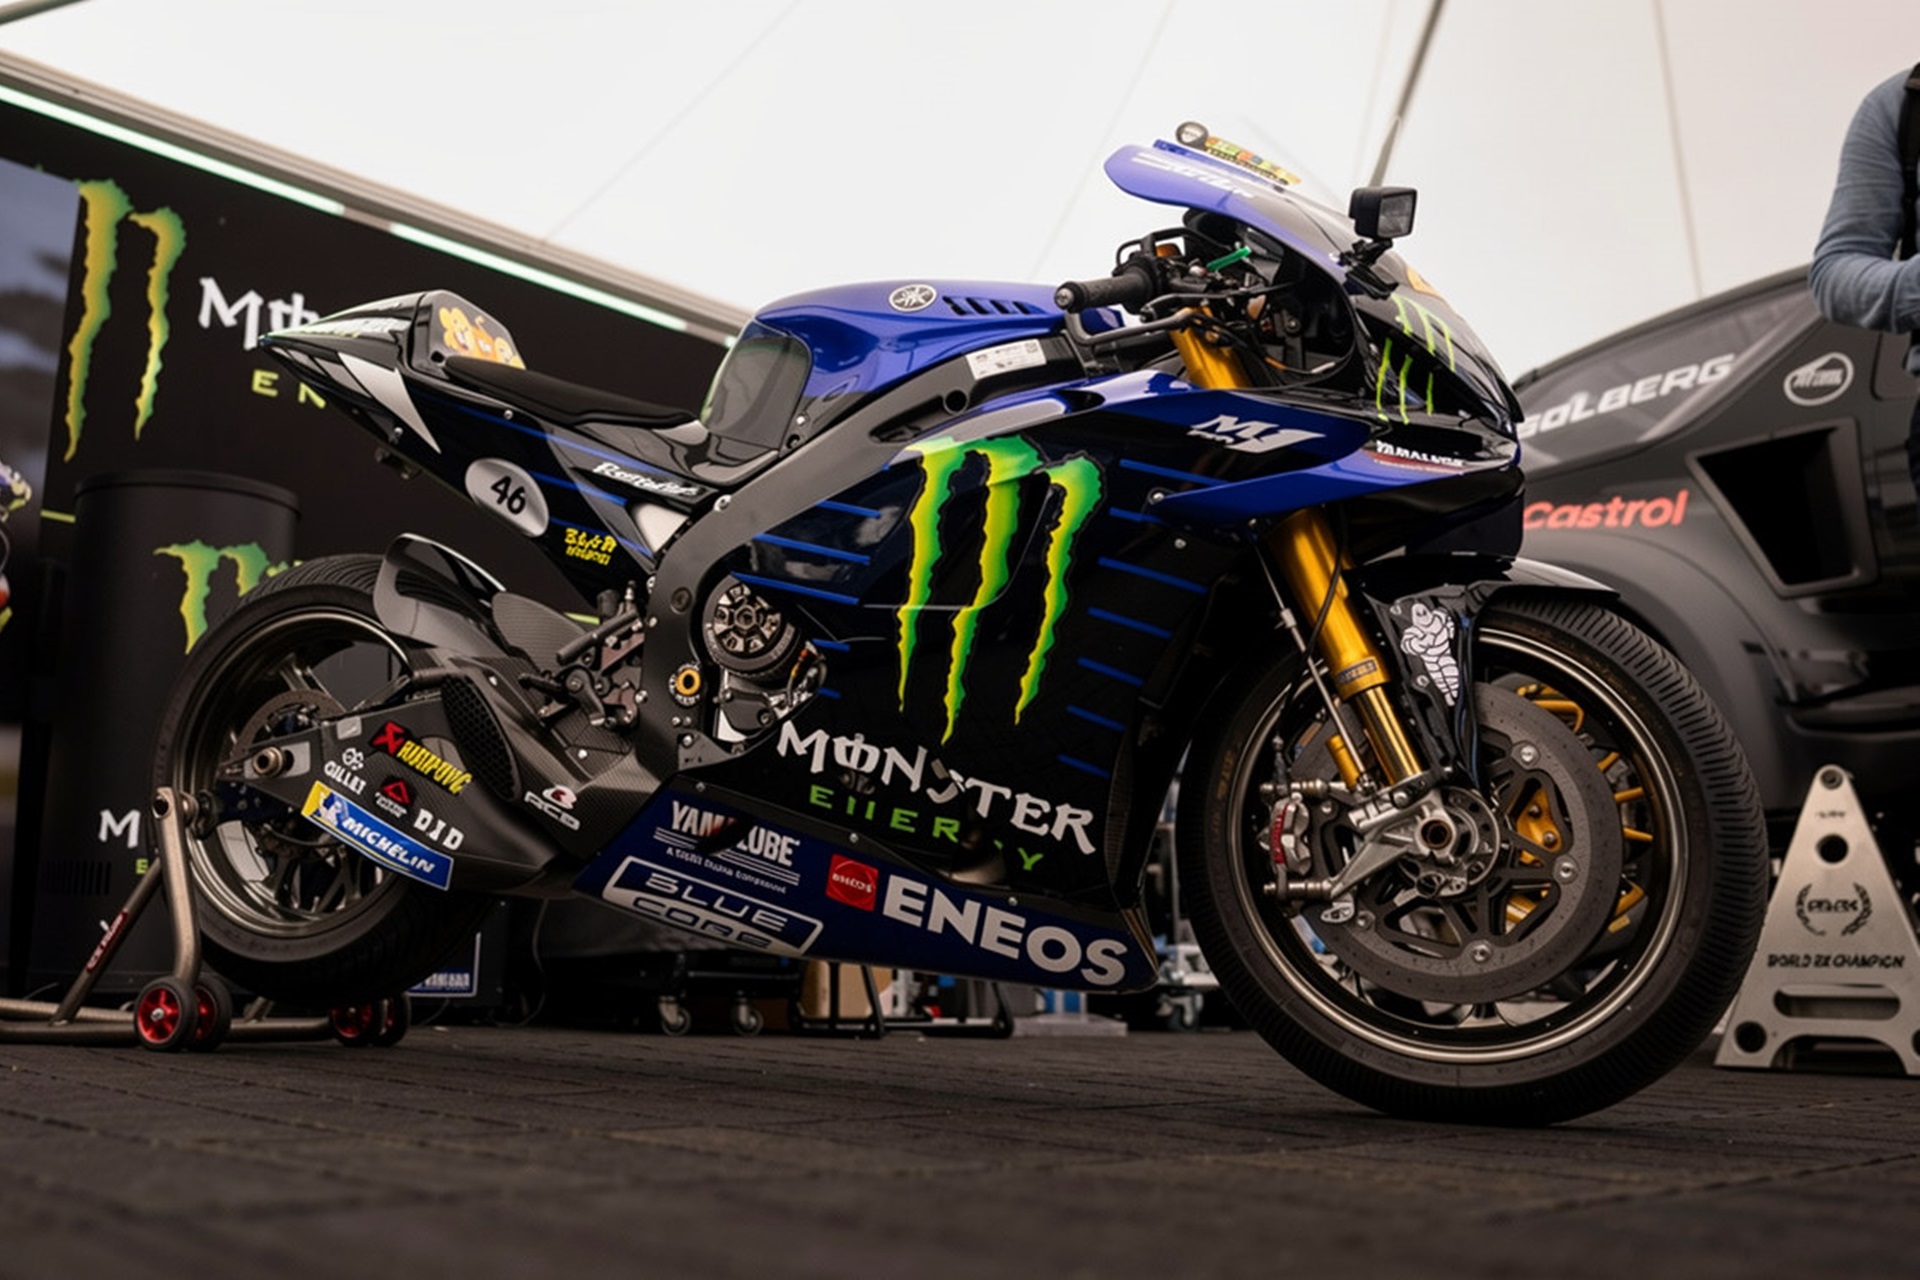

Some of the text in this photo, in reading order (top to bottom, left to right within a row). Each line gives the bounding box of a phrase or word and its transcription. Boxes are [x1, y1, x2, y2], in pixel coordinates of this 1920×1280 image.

[490, 475, 526, 516] 46
[1523, 489, 1690, 531] Castrol
[777, 719, 1097, 856] MONSTER
[341, 816, 436, 873] MICHELIN
[882, 874, 1128, 987] ENEOS
